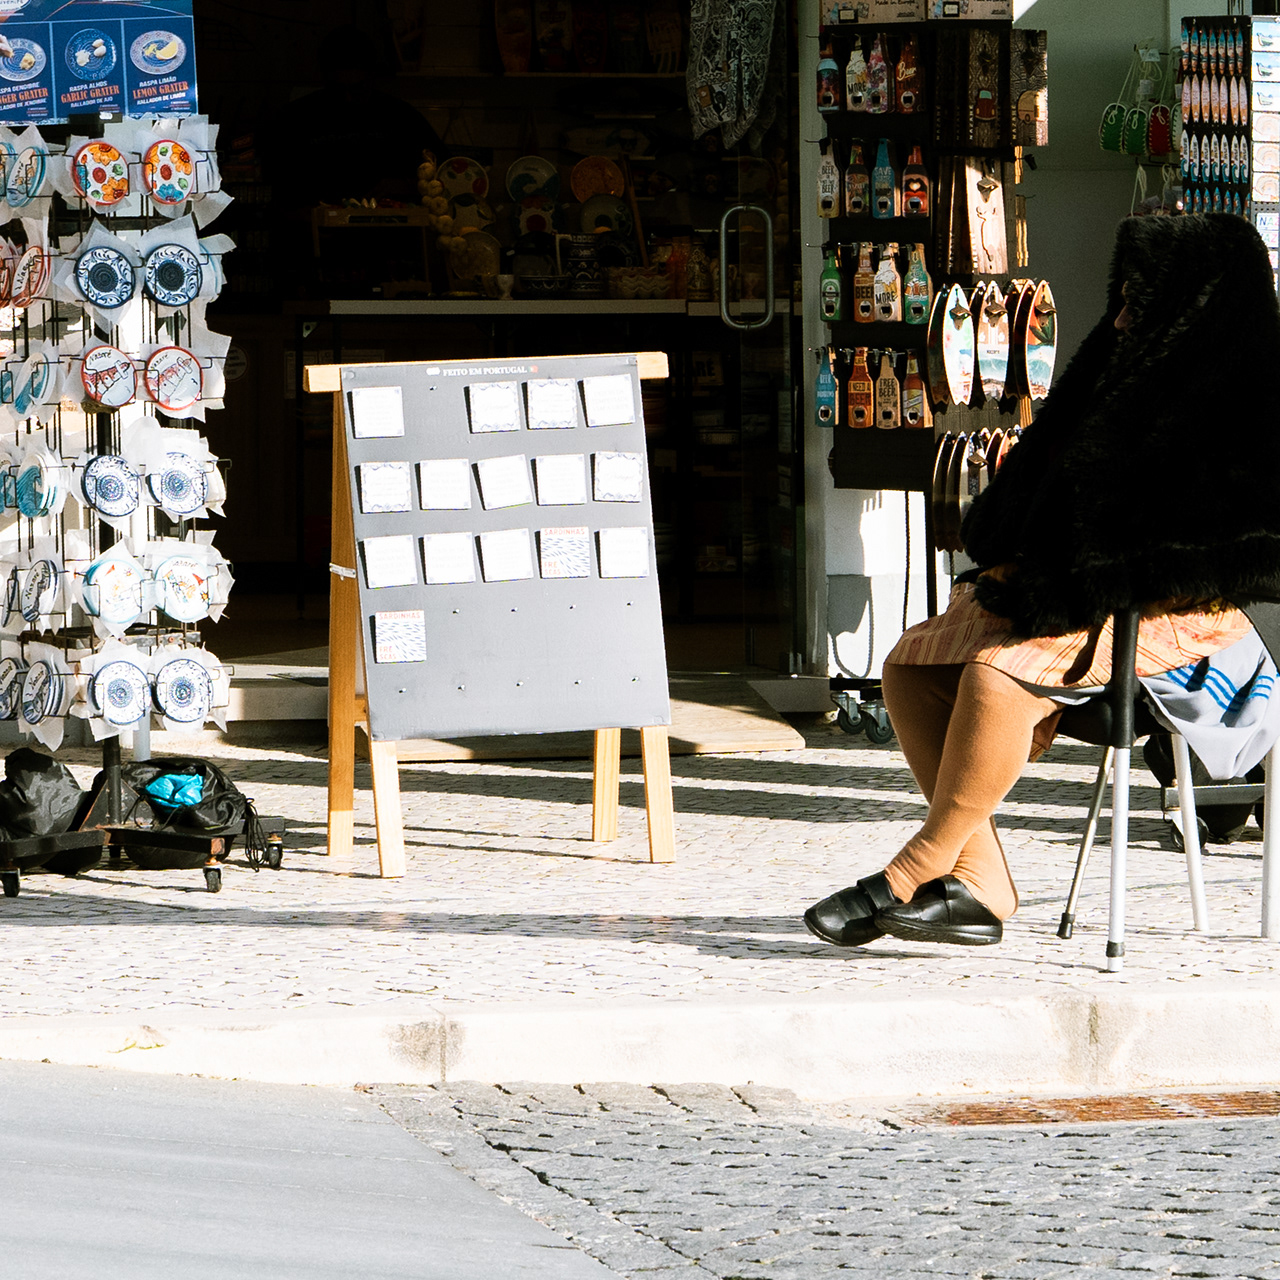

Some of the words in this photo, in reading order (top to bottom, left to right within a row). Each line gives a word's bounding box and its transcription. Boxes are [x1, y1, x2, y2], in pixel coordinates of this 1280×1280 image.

[69, 84, 89, 92] RASPA
[89, 80, 108, 89] ALHOS
[139, 80, 158, 88] RASPA
[847, 81, 867, 95] MORE
[19, 87, 49, 102] GRATER
[61, 89, 88, 104] GARLIC
[89, 85, 120, 100] GRATER
[132, 86, 158, 100] LEMON
[159, 81, 190, 96] GRATER
[821, 165, 835, 175] BEER
[821, 184, 835, 194] BEER
[875, 290, 898, 305] MORE
[442, 369, 467, 377] FEITO
[483, 366, 528, 375] PORTUGAL
[819, 372, 831, 384] BEER
[880, 378, 895, 387] FREE
[853, 383, 867, 392] NEED
[849, 394, 871, 405] BEER
[543, 527, 586, 536] SARDINHAS
[543, 561, 559, 569] FRE
[543, 569, 562, 577] SCAS
[378, 612, 421, 621] SARDINHAS
[378, 645, 394, 653] FRE
[378, 653, 398, 661] SCAS
